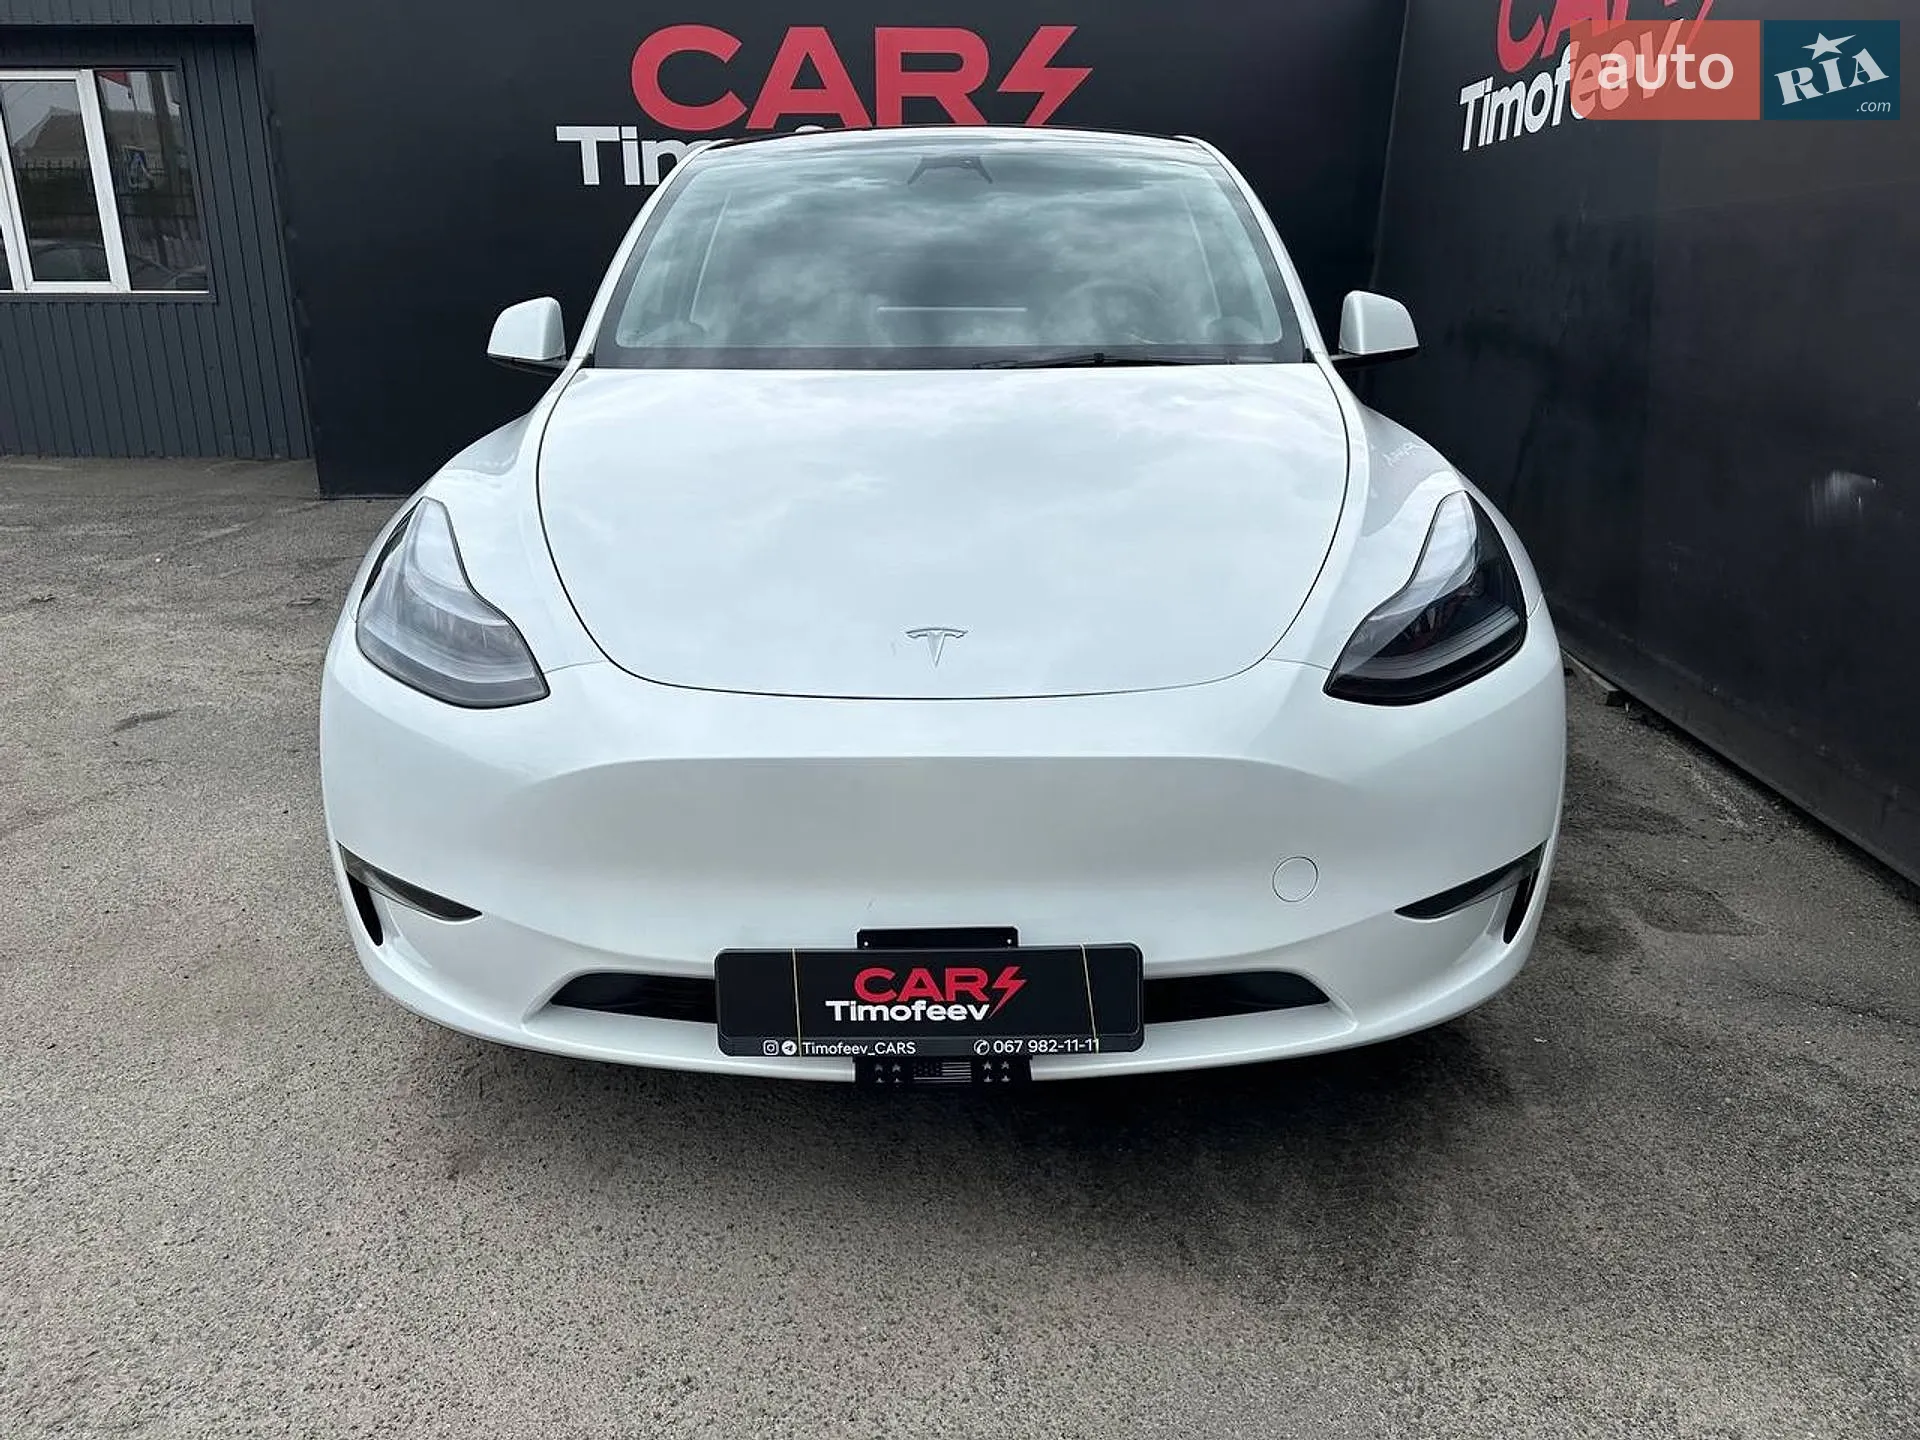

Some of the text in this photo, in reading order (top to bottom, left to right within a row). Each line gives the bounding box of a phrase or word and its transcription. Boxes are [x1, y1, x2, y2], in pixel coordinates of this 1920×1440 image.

[825, 1000, 990, 1022] Timofeev
[802, 1038, 1100, 1056] Timofeev_CARS 067 982-11-11
